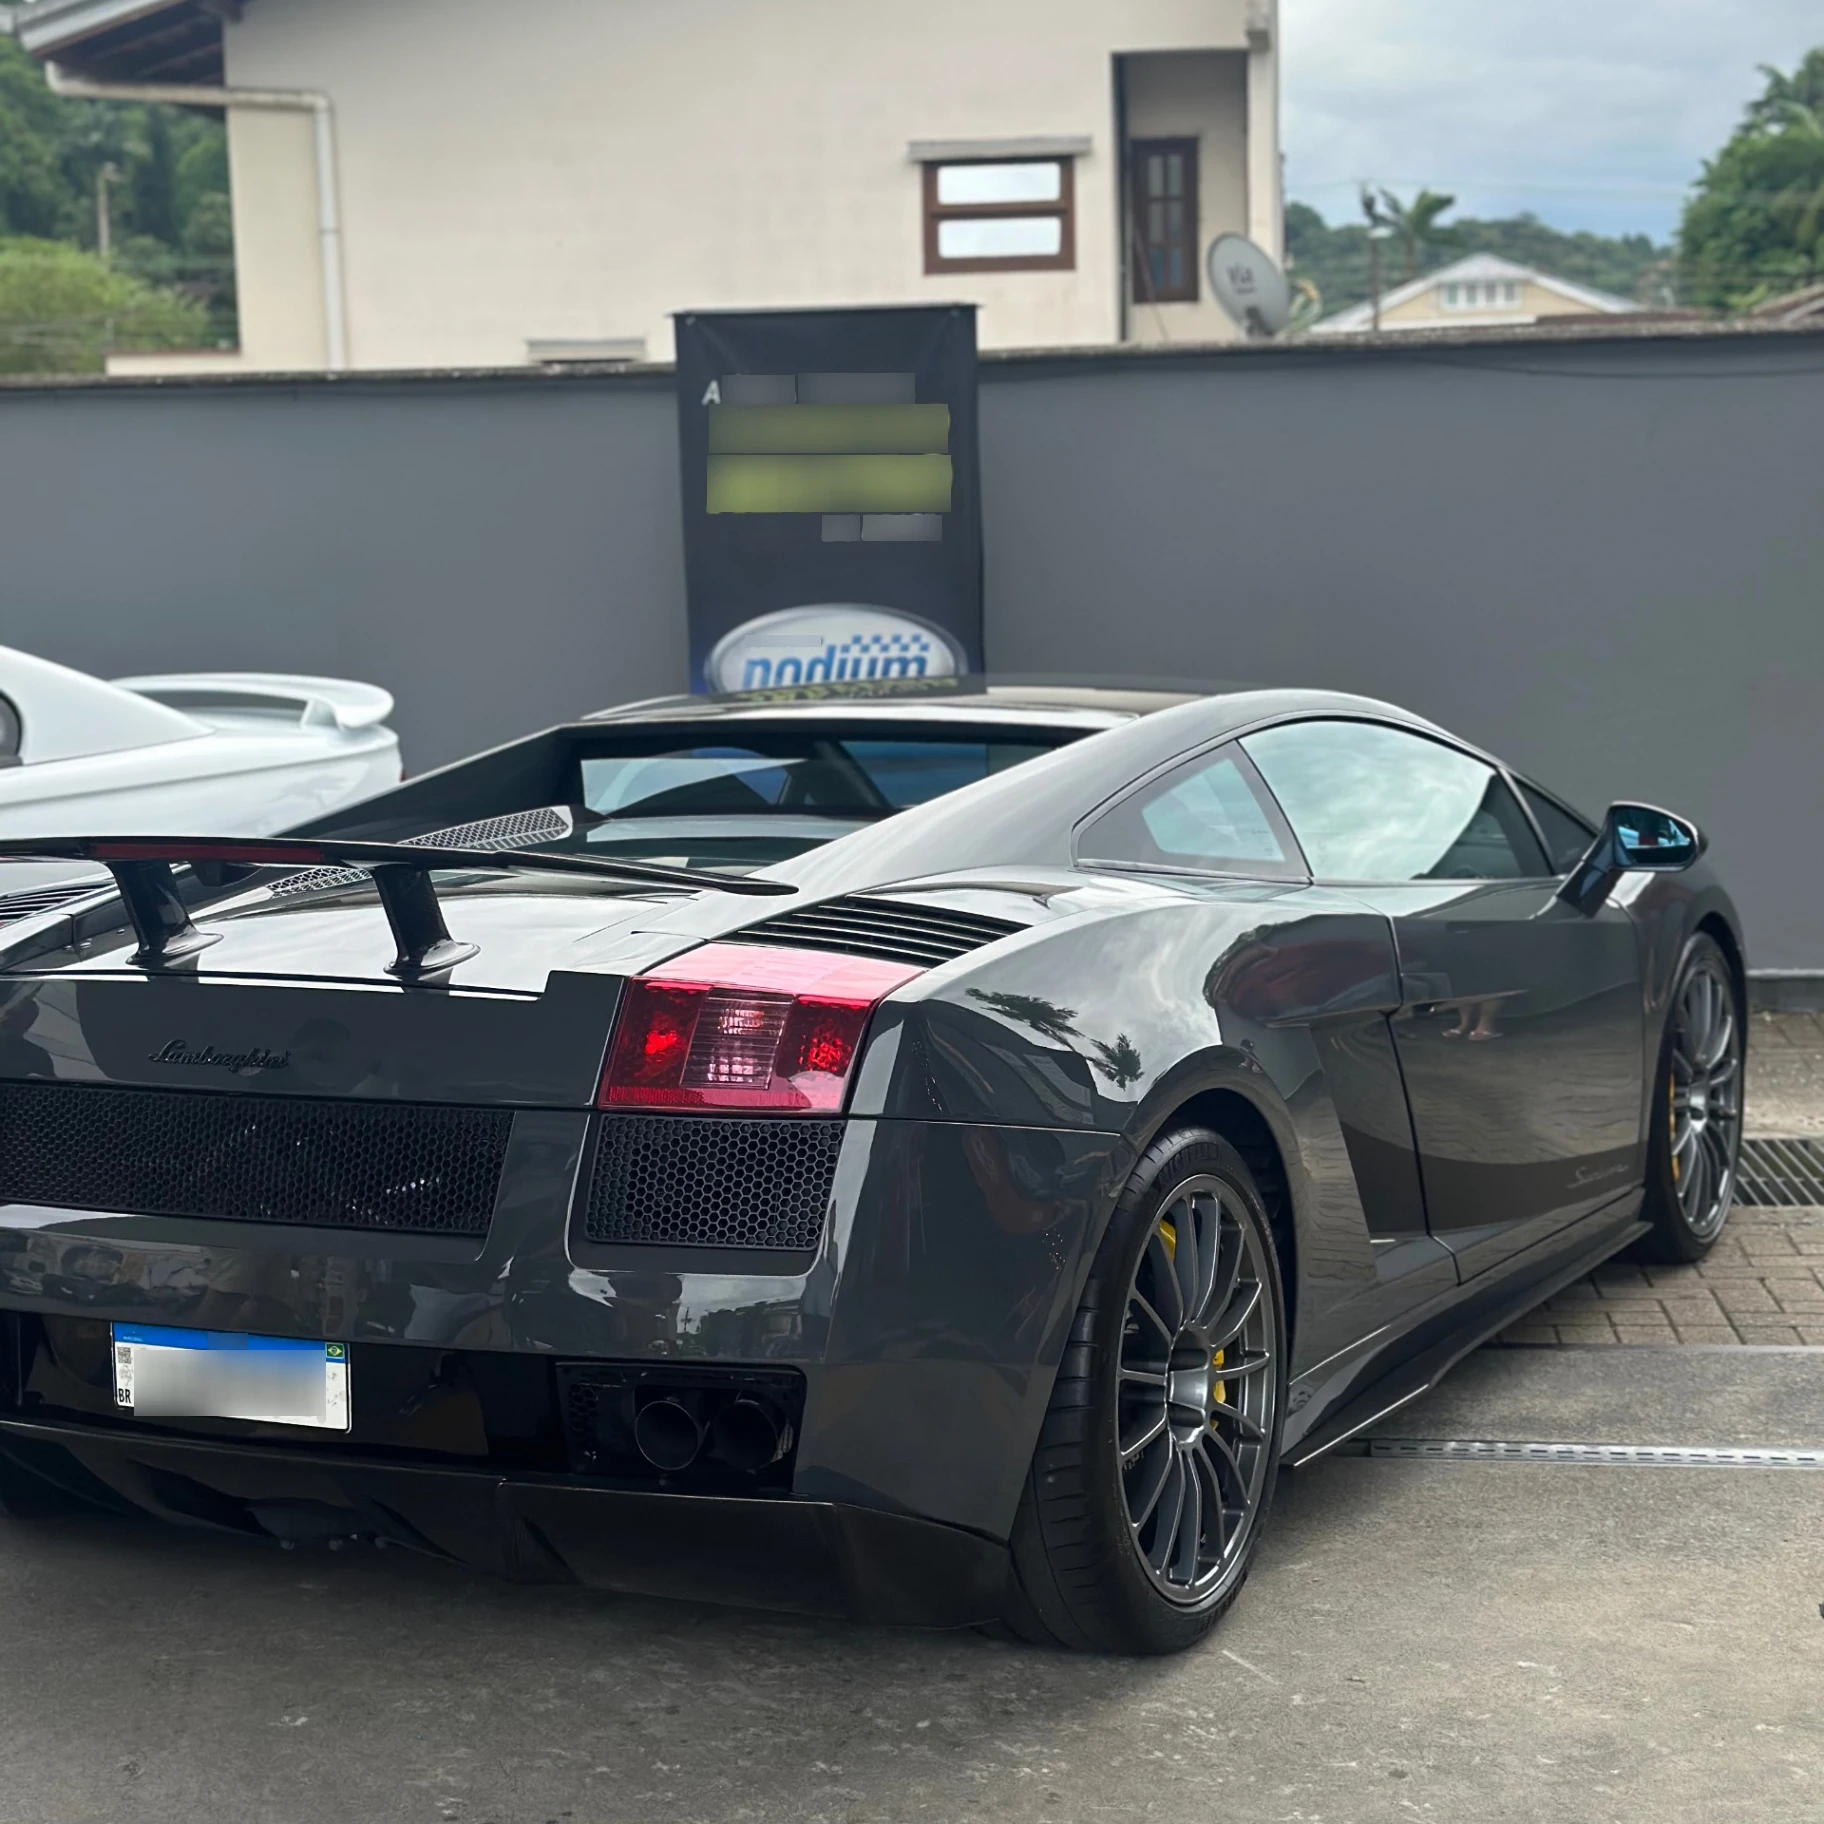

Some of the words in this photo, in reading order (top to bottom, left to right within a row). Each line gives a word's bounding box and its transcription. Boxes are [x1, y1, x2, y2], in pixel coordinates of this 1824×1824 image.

[701, 379, 722, 405] A
[148, 1039, 291, 1074] Lamborghini
[118, 1387, 132, 1404] BR
